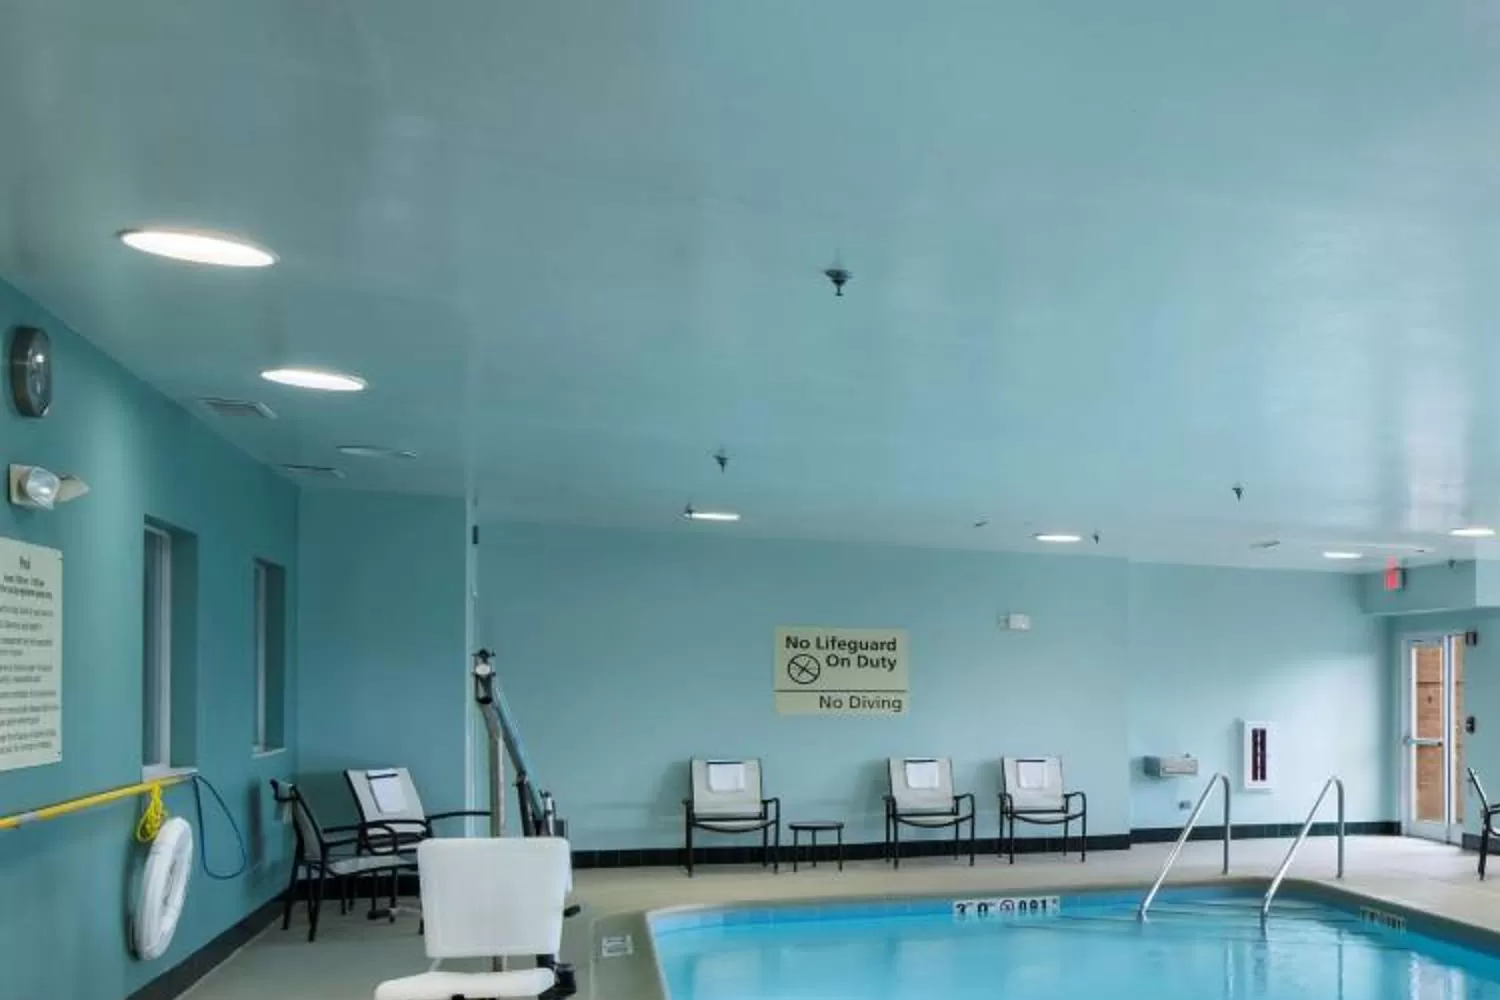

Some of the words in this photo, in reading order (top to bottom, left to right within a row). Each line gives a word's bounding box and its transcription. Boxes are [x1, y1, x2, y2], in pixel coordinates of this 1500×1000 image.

[785, 636, 811, 649] No
[816, 636, 897, 654] Lifeguard
[826, 654, 850, 667] On
[857, 655, 897, 672] Duty
[819, 696, 843, 709] No
[849, 696, 902, 712] Diving
